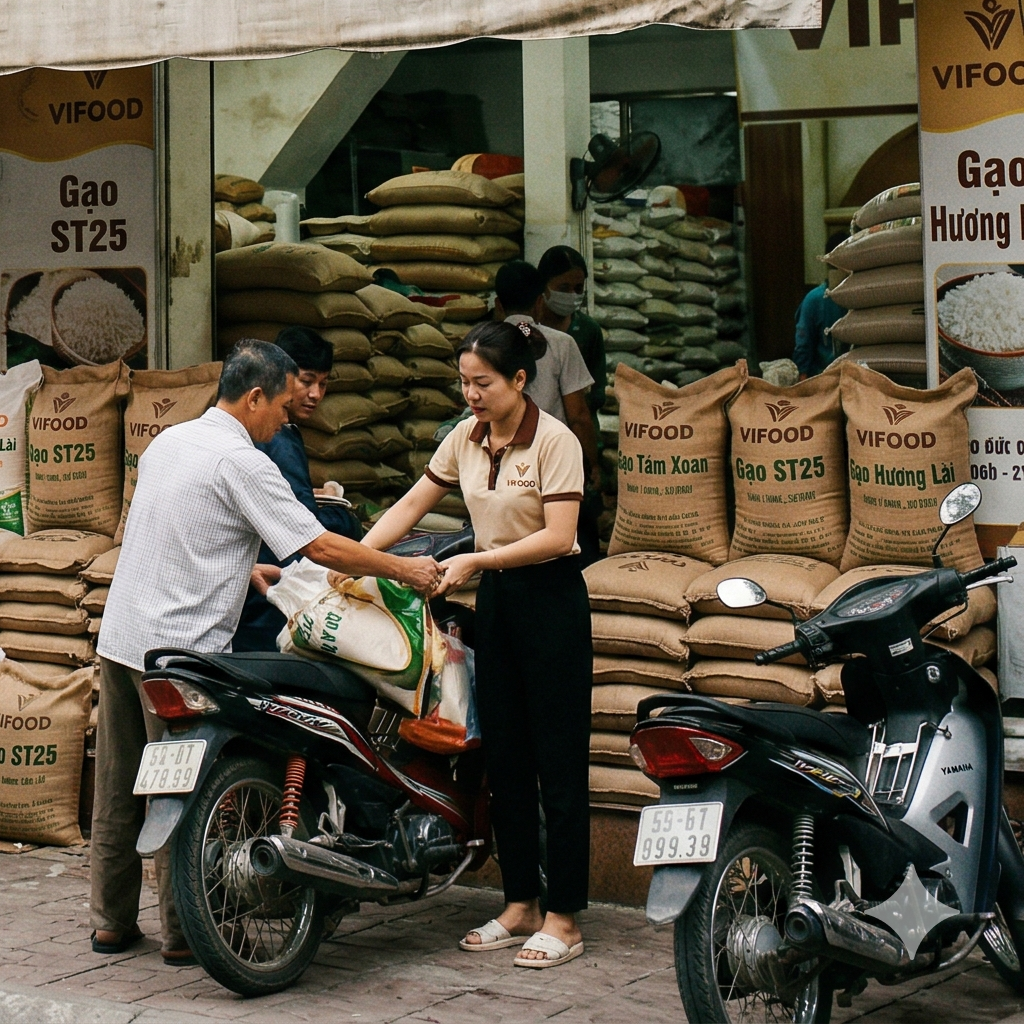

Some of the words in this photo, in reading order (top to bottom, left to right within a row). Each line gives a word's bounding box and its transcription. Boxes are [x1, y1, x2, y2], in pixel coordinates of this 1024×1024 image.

[49, 98, 143, 125] VIFOOD
[957, 150, 1024, 197] Gạo
[59, 175, 118, 214] Gạo
[51, 219, 127, 253] ST25
[930, 205, 1011, 249] Hương
[32, 416, 88, 431] VIFOOD
[625, 422, 694, 440] VIFOOD
[740, 425, 814, 444] VIFOOD
[856, 429, 936, 449] VIFOOD
[53, 443, 96, 463] ST25
[636, 454, 666, 475] Tám
[671, 455, 709, 475] Xoan
[736, 457, 766, 485] Gạo
[774, 455, 825, 482] ST25
[875, 463, 926, 491] Hương
[11, 744, 58, 766] ST25
